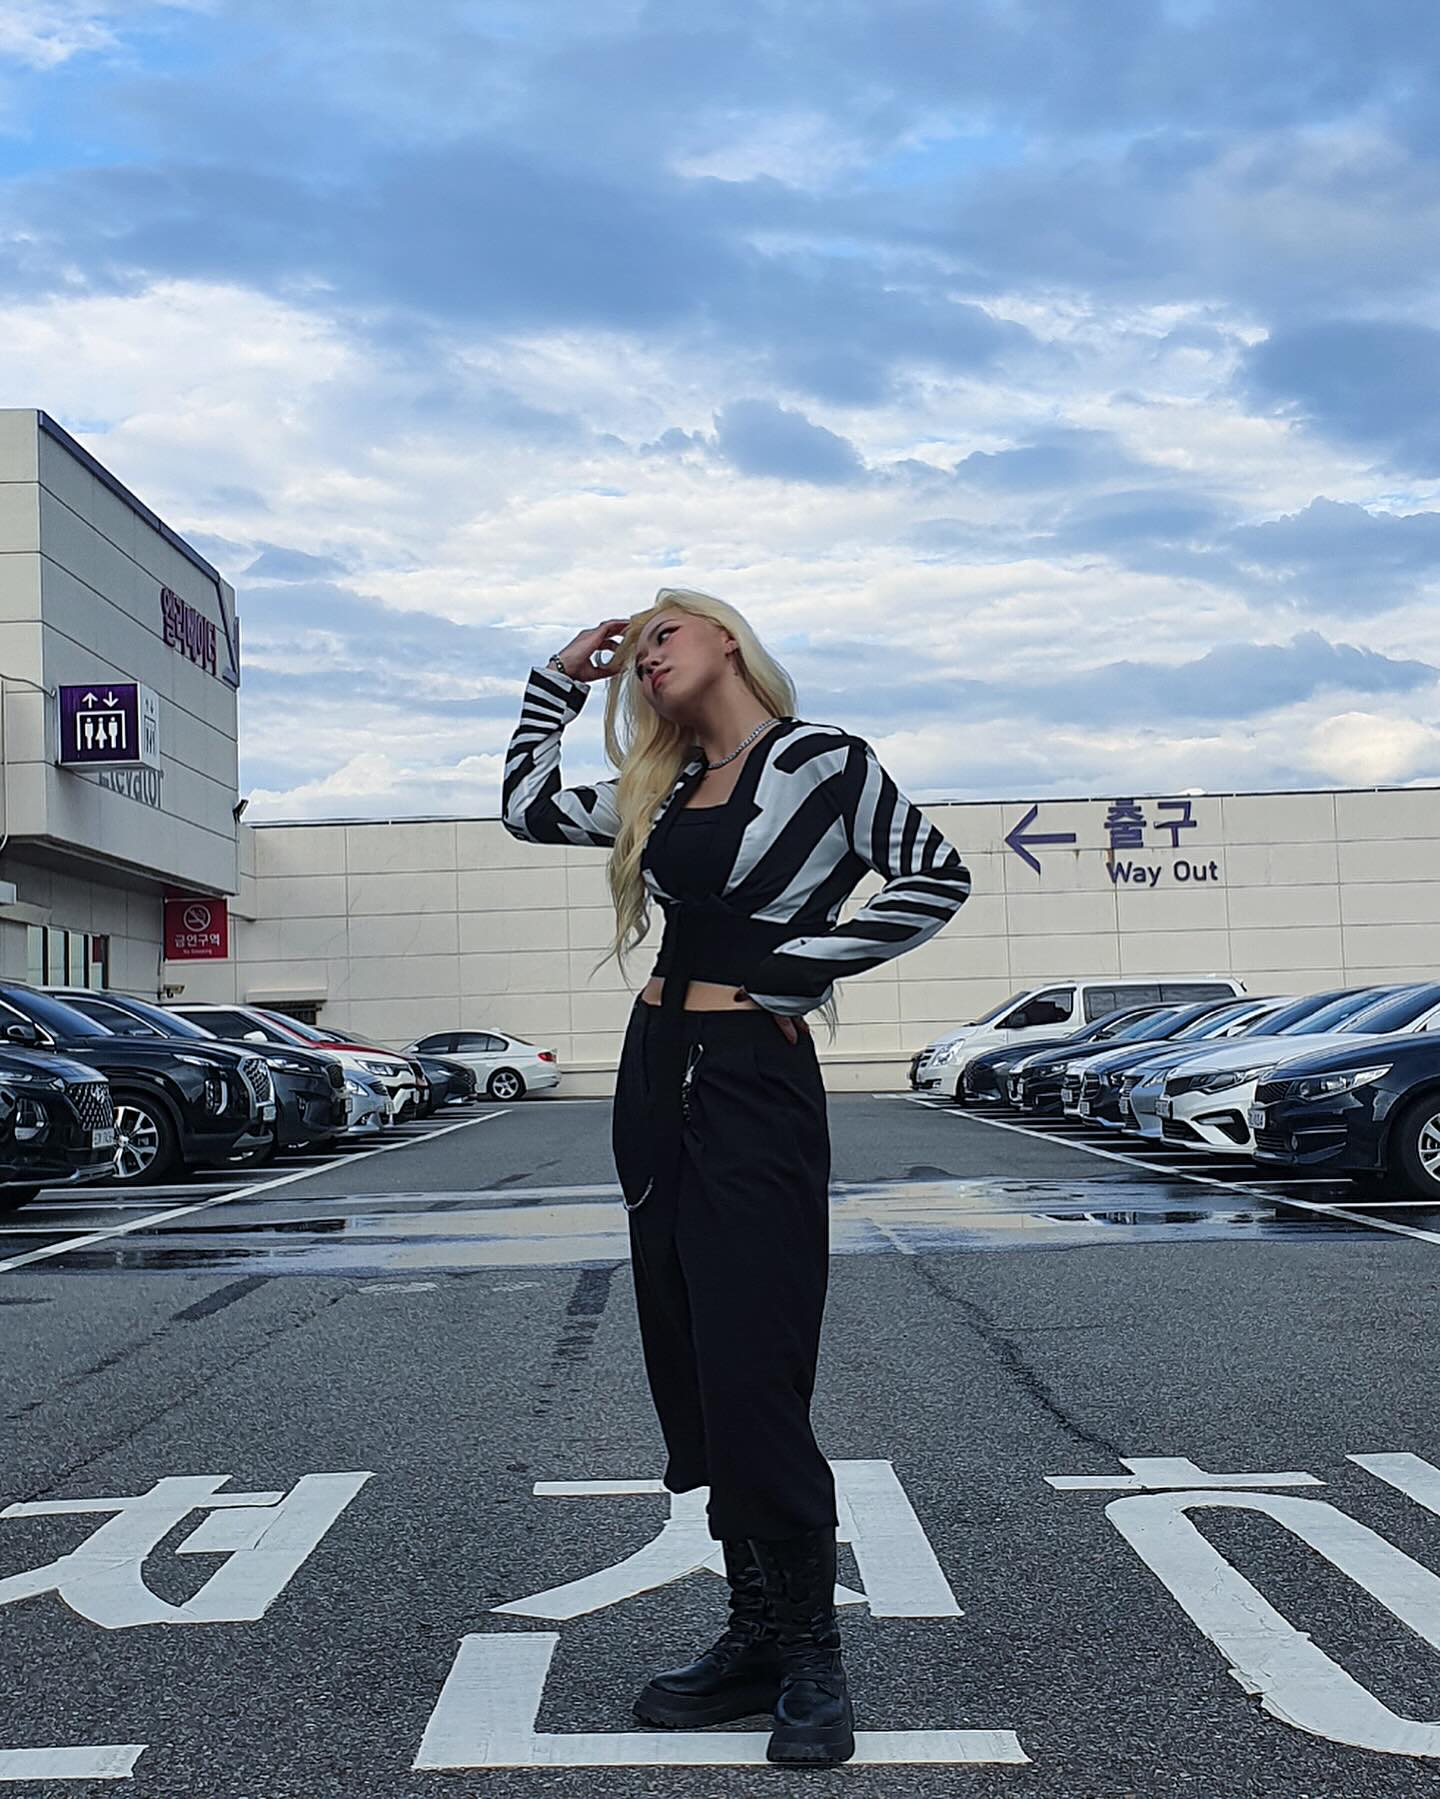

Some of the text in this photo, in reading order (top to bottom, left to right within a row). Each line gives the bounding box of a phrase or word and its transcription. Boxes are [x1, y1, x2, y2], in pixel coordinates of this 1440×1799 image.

[160, 587, 217, 677] 엘리베이터
[1104, 799, 1197, 849] 출구
[1106, 861, 1218, 887] Way Out
[175, 933, 220, 948] 금연구역
